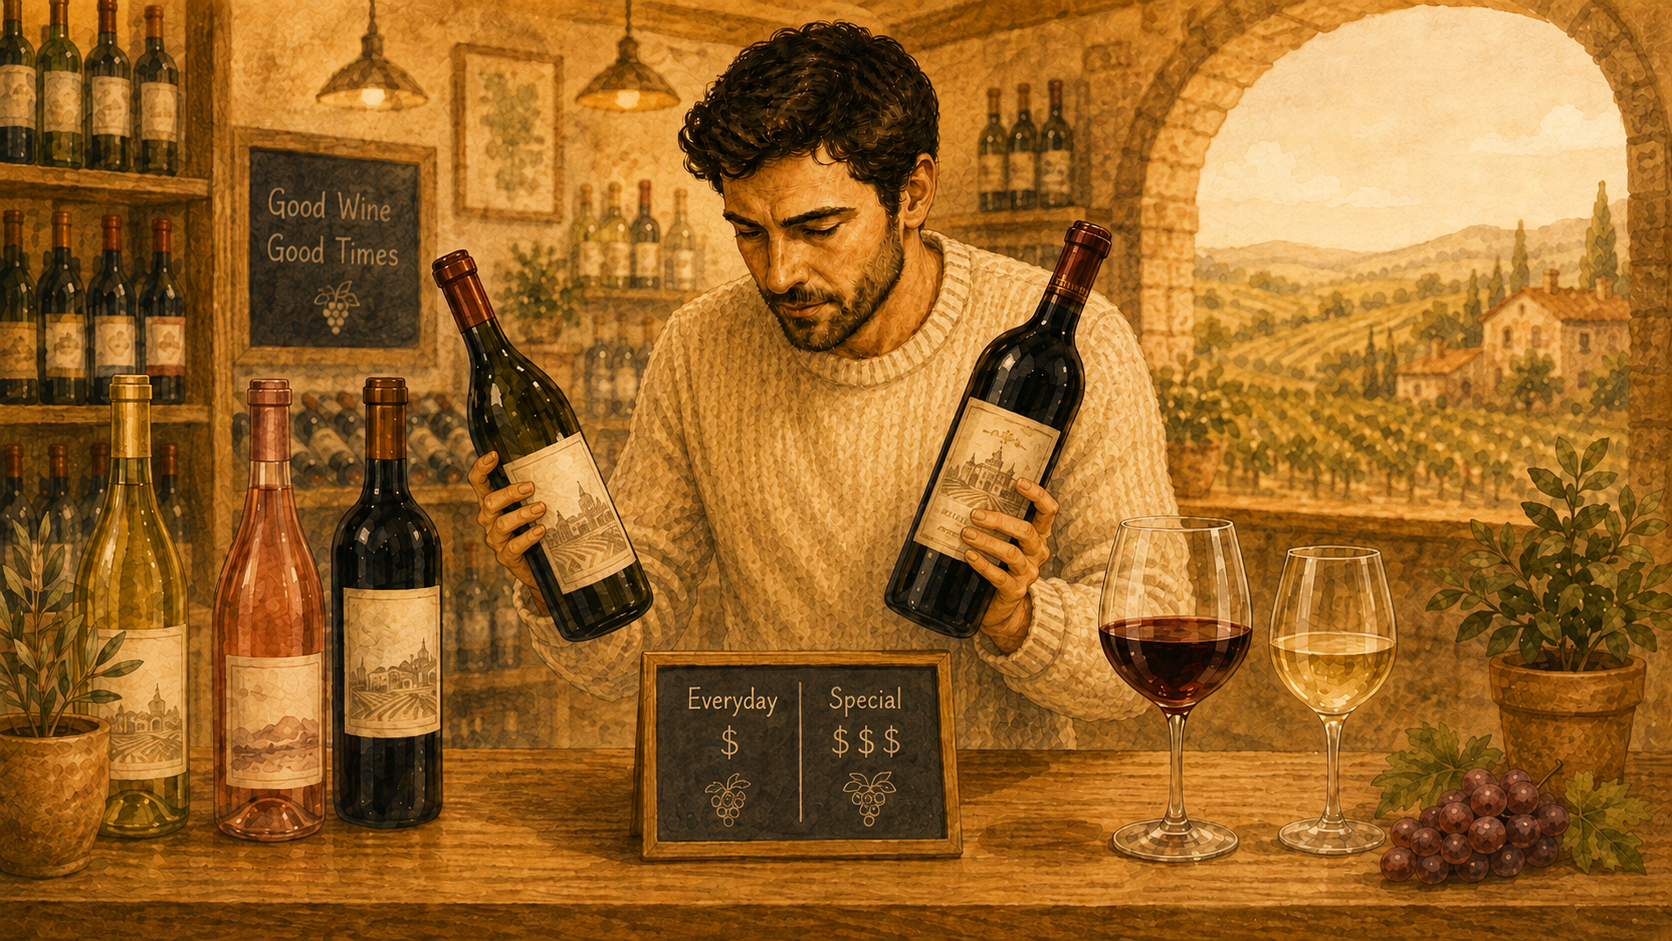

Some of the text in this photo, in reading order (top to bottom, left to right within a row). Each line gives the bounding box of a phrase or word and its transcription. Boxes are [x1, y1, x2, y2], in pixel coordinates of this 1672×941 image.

[268, 187, 391, 222] Good Wine
[267, 233, 399, 266] Good Times
[688, 686, 778, 717] Everyday
[829, 686, 901, 717] Special
[721, 725, 739, 760] $
